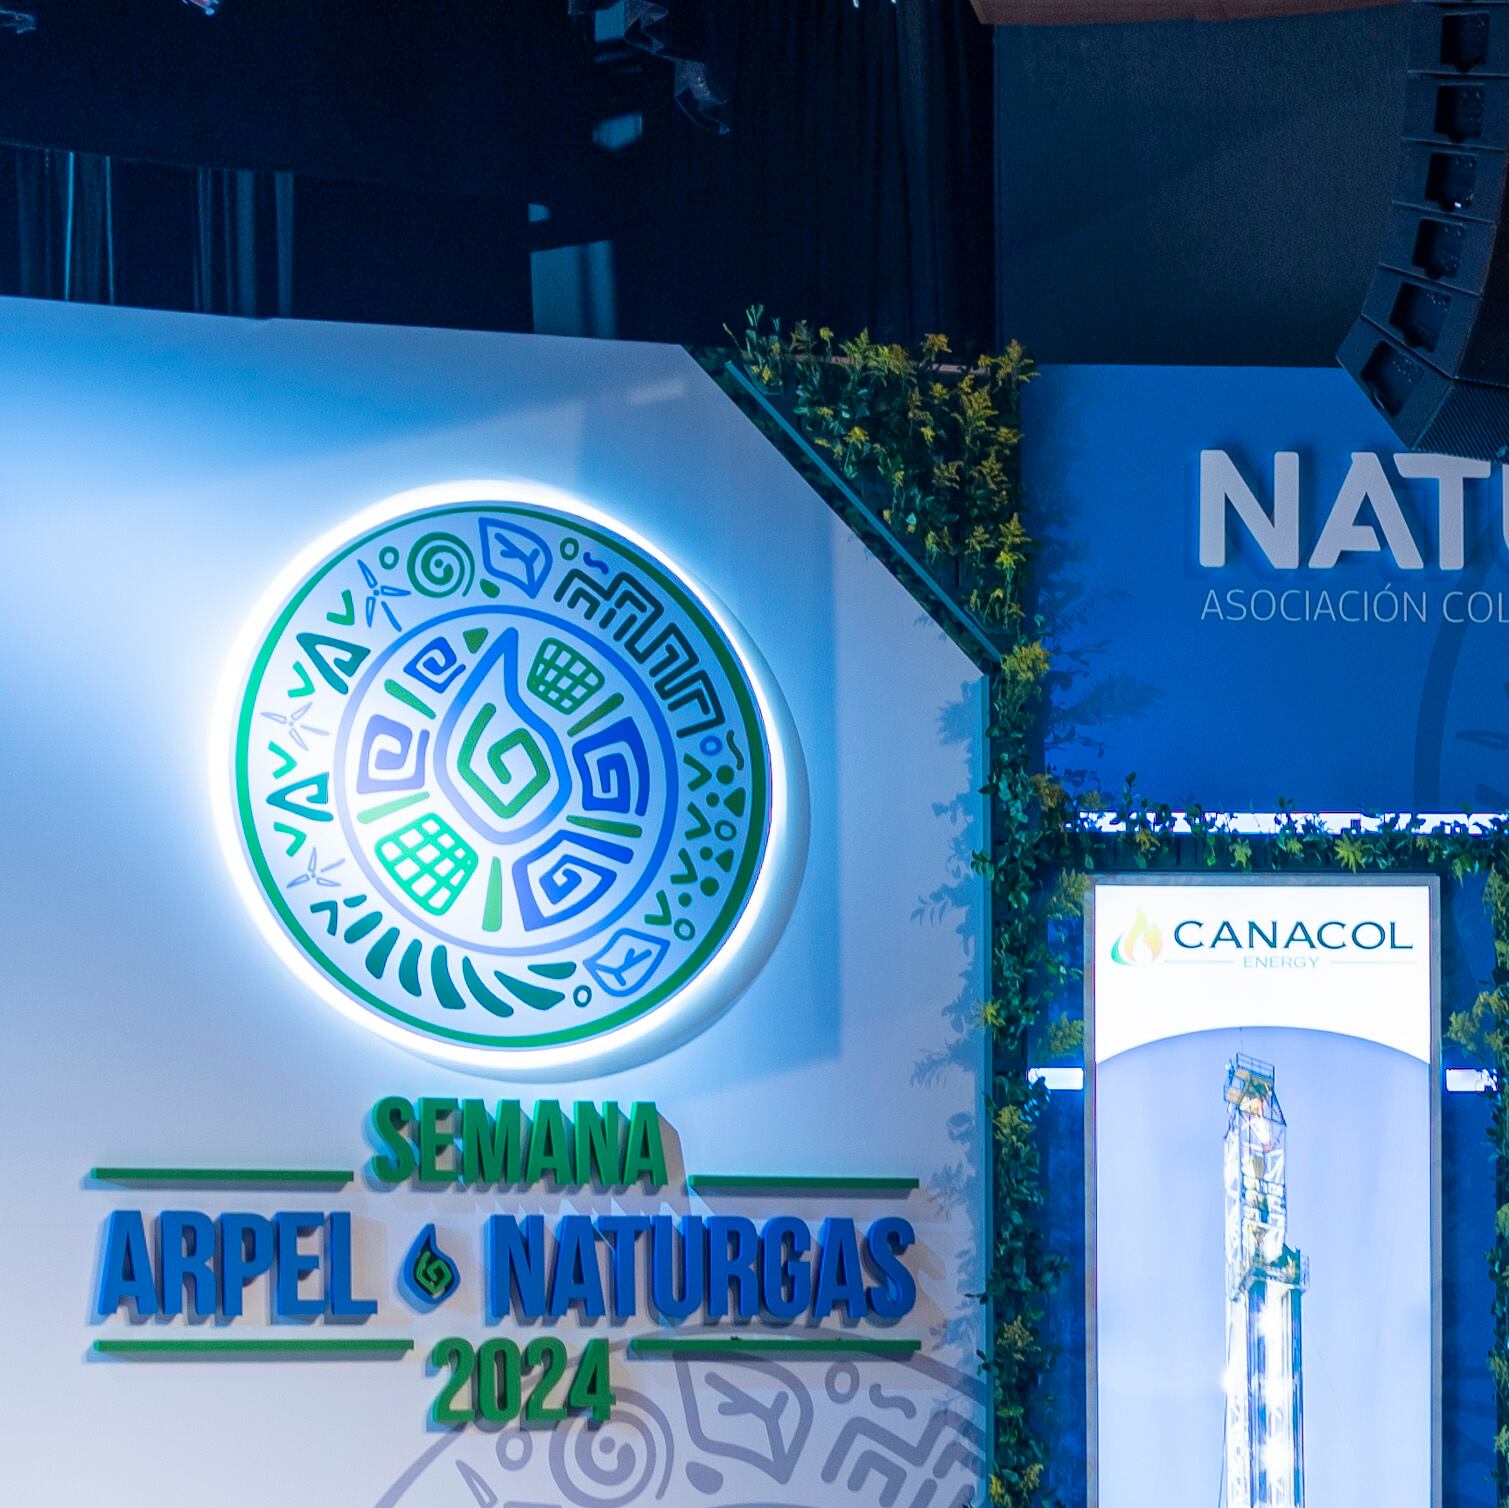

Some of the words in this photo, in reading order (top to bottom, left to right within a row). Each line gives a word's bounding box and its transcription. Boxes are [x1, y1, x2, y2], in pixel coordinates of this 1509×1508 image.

[1200, 580, 1427, 624] ASOCIACIÓN
[1173, 920, 1414, 950] CANACOL
[1243, 956, 1320, 969] ENERGY
[371, 1096, 669, 1187] SEMANA
[96, 1209, 379, 1318] ARPEL
[488, 1214, 917, 1320] NATURGAS
[430, 1336, 617, 1423] 2024
